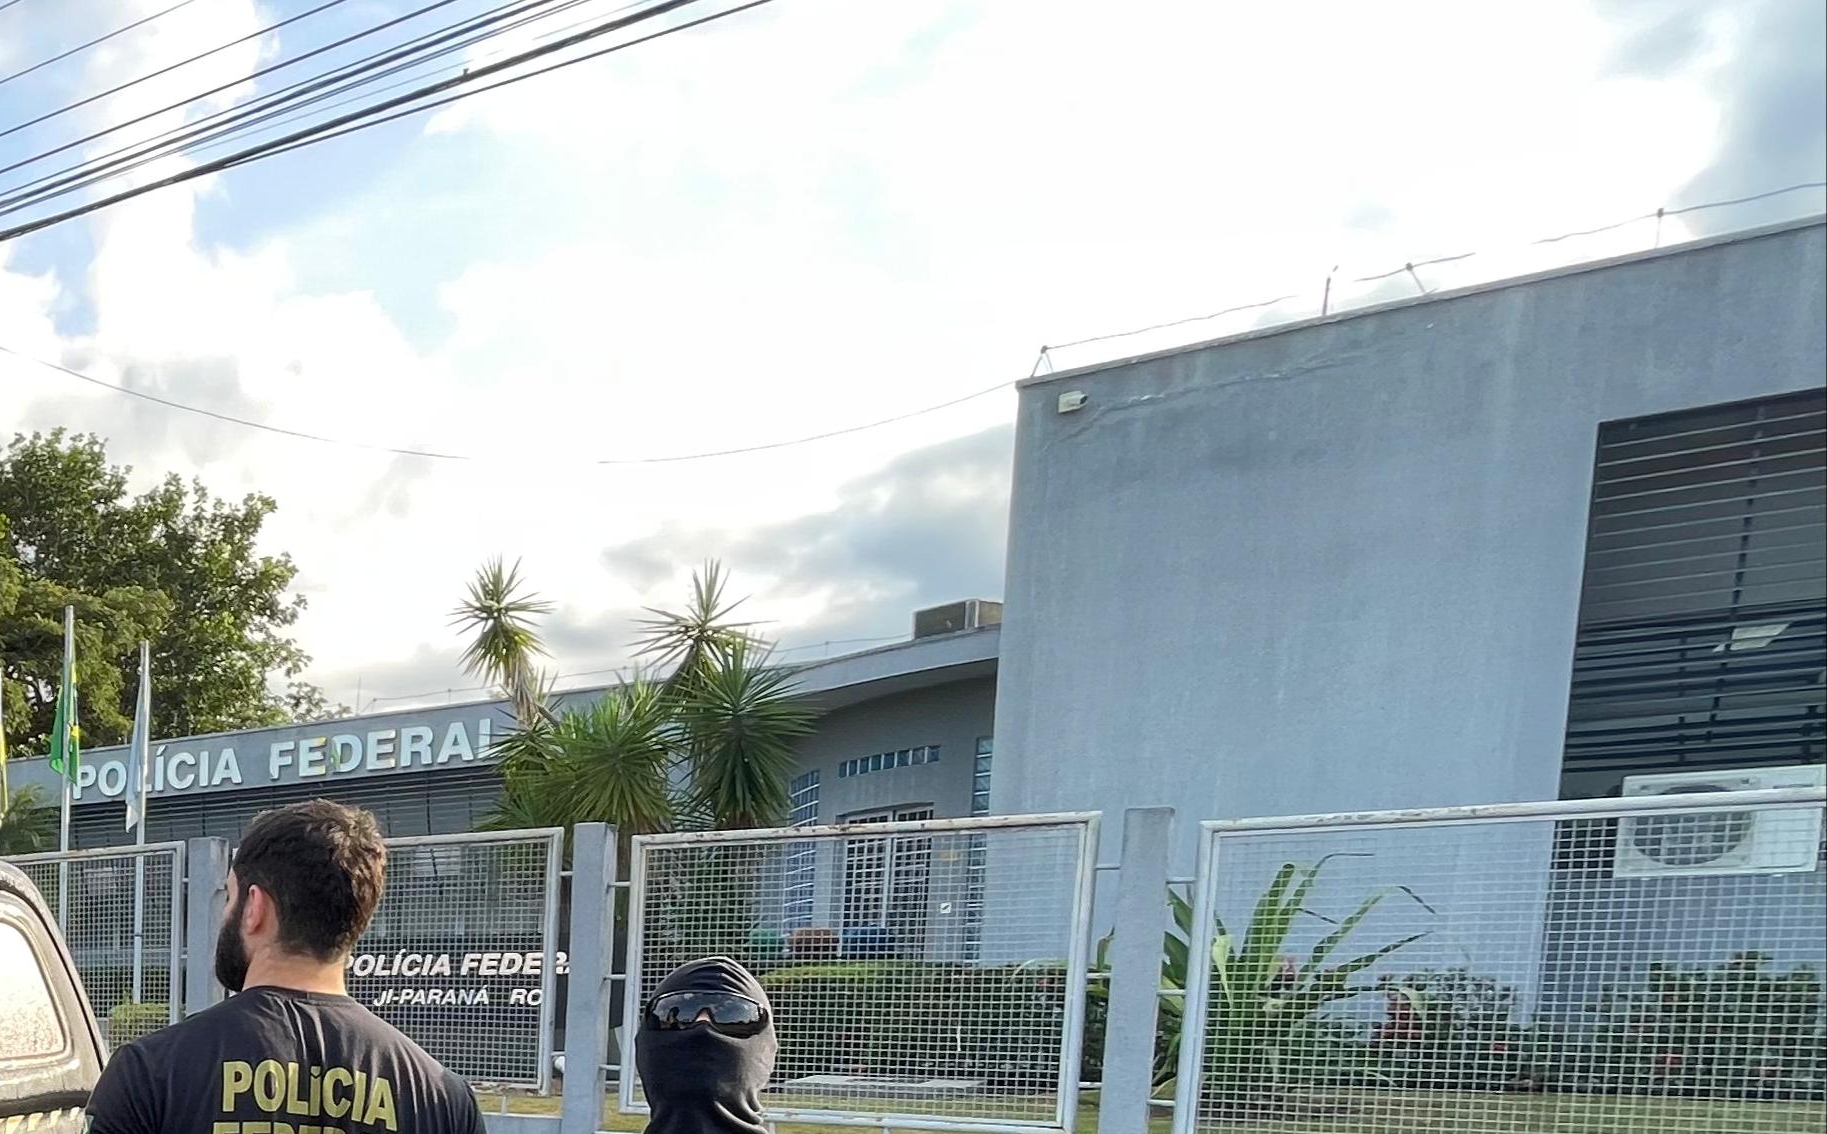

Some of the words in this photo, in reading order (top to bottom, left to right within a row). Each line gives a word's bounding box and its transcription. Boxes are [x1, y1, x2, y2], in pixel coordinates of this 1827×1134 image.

[460, 951, 570, 976] FEDER
[373, 984, 489, 1007] JI-PARANÁ
[509, 988, 543, 1006] RO
